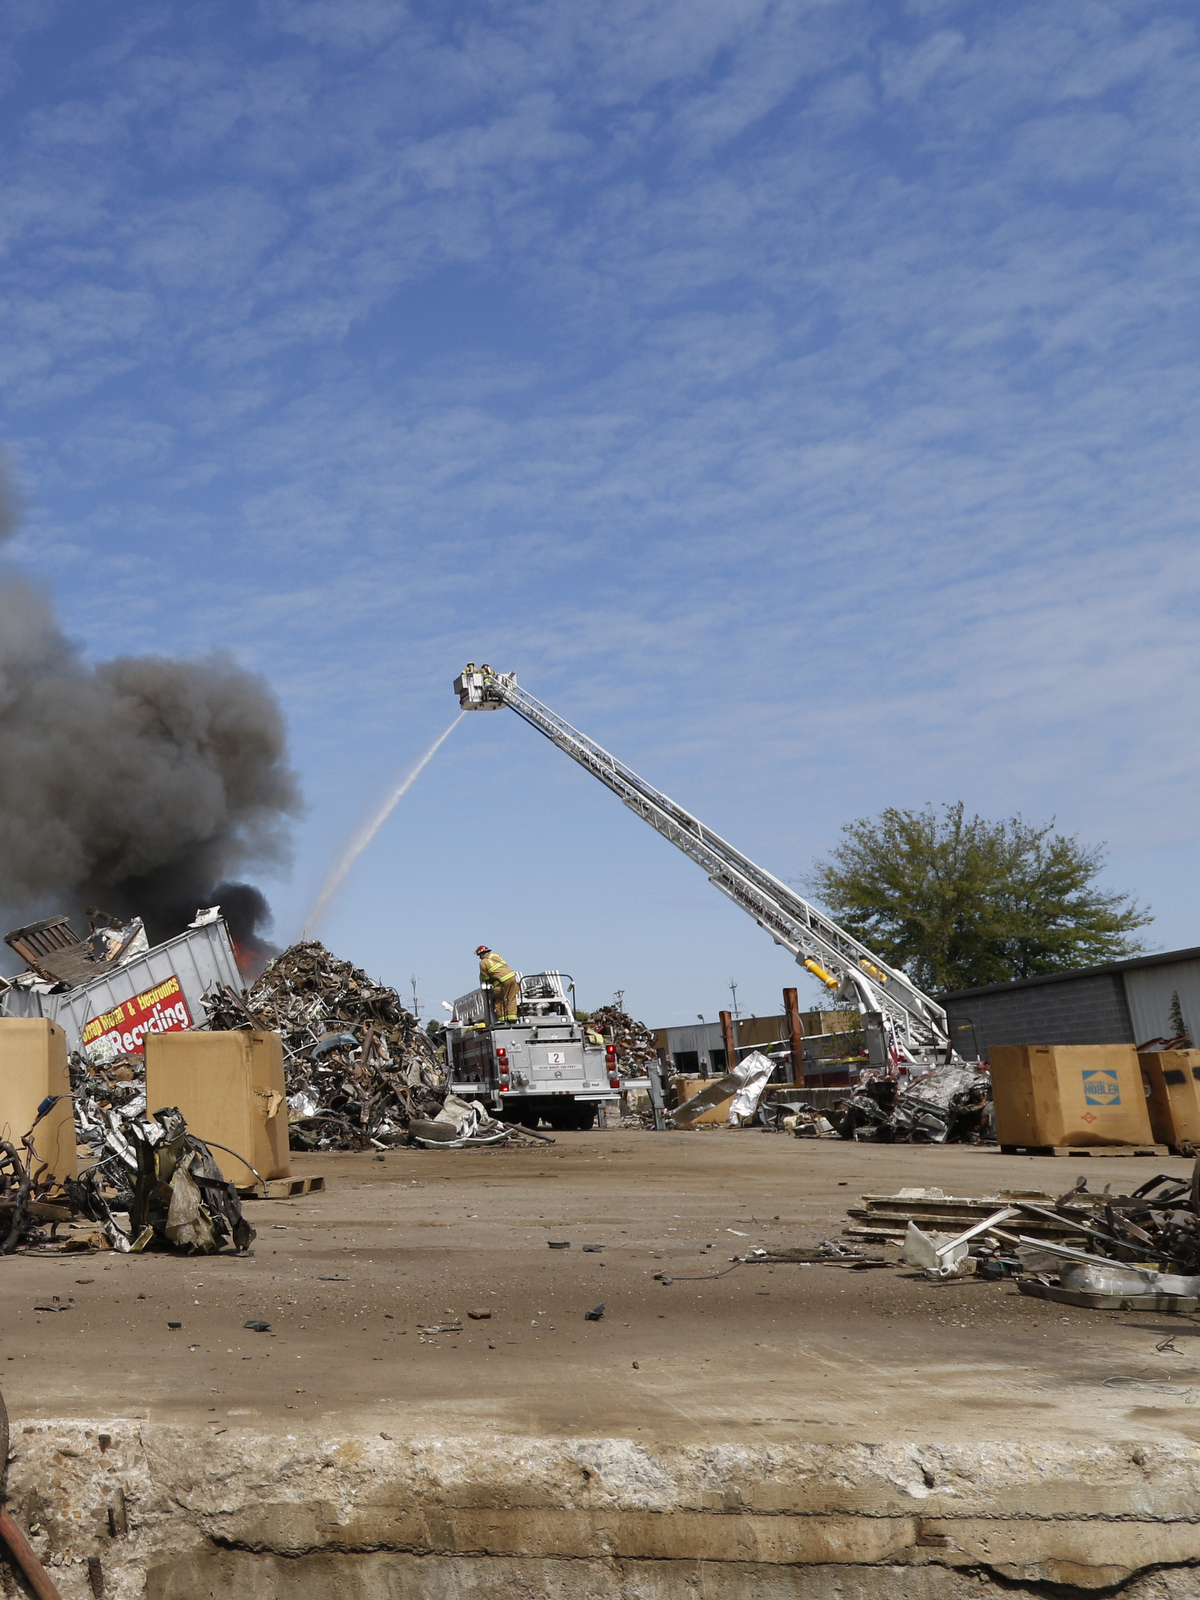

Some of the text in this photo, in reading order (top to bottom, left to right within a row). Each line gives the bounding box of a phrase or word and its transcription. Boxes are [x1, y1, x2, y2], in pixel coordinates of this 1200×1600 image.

[100, 1007, 126, 1031] Metal
[127, 1002, 137, 1016] &
[137, 978, 180, 1011] Electronics
[109, 1001, 189, 1056] Recycling
[553, 1053, 560, 1063] 2
